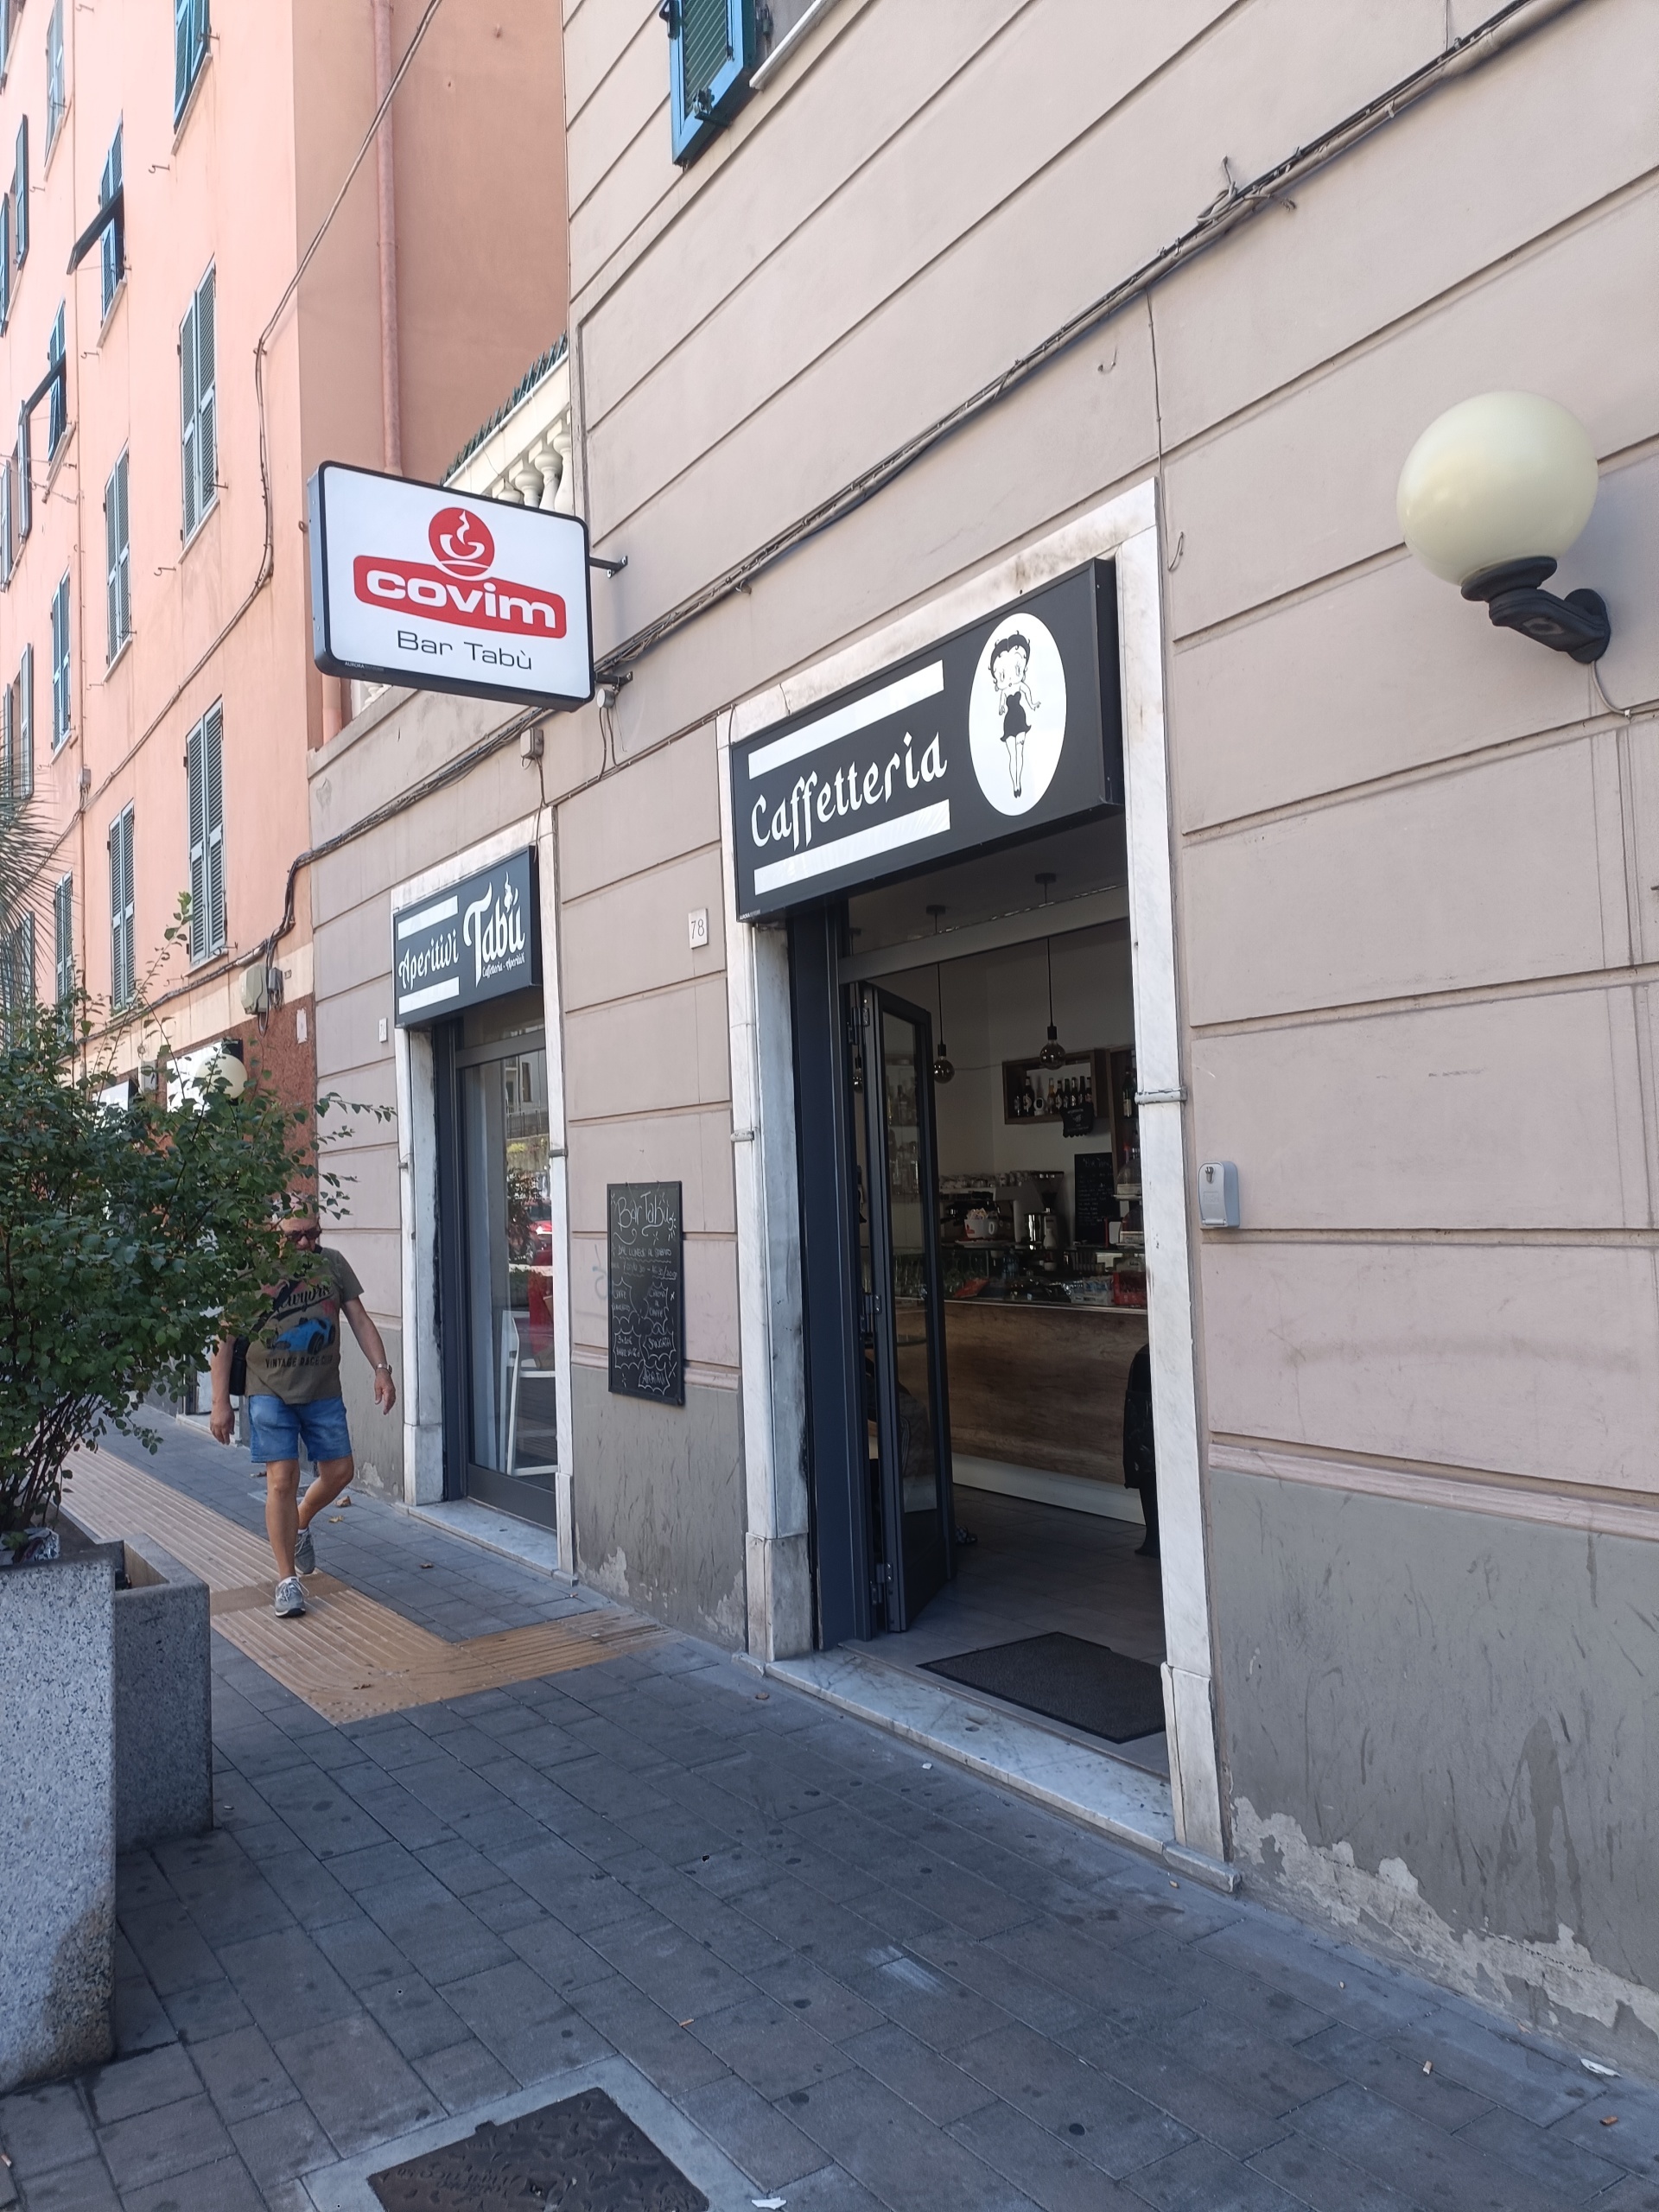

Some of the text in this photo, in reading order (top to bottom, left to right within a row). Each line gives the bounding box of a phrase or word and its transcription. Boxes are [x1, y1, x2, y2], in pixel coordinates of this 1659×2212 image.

[366, 570, 556, 629] covim
[397, 630, 532, 671] Bar Tabù
[751, 731, 948, 851] Caffetteria
[691, 918, 704, 939] 78
[398, 928, 460, 990] Aperitivi
[617, 1197, 642, 1232] Bar
[265, 1357, 297, 1368] VINTAGE
[300, 1356, 320, 1366] RACE
